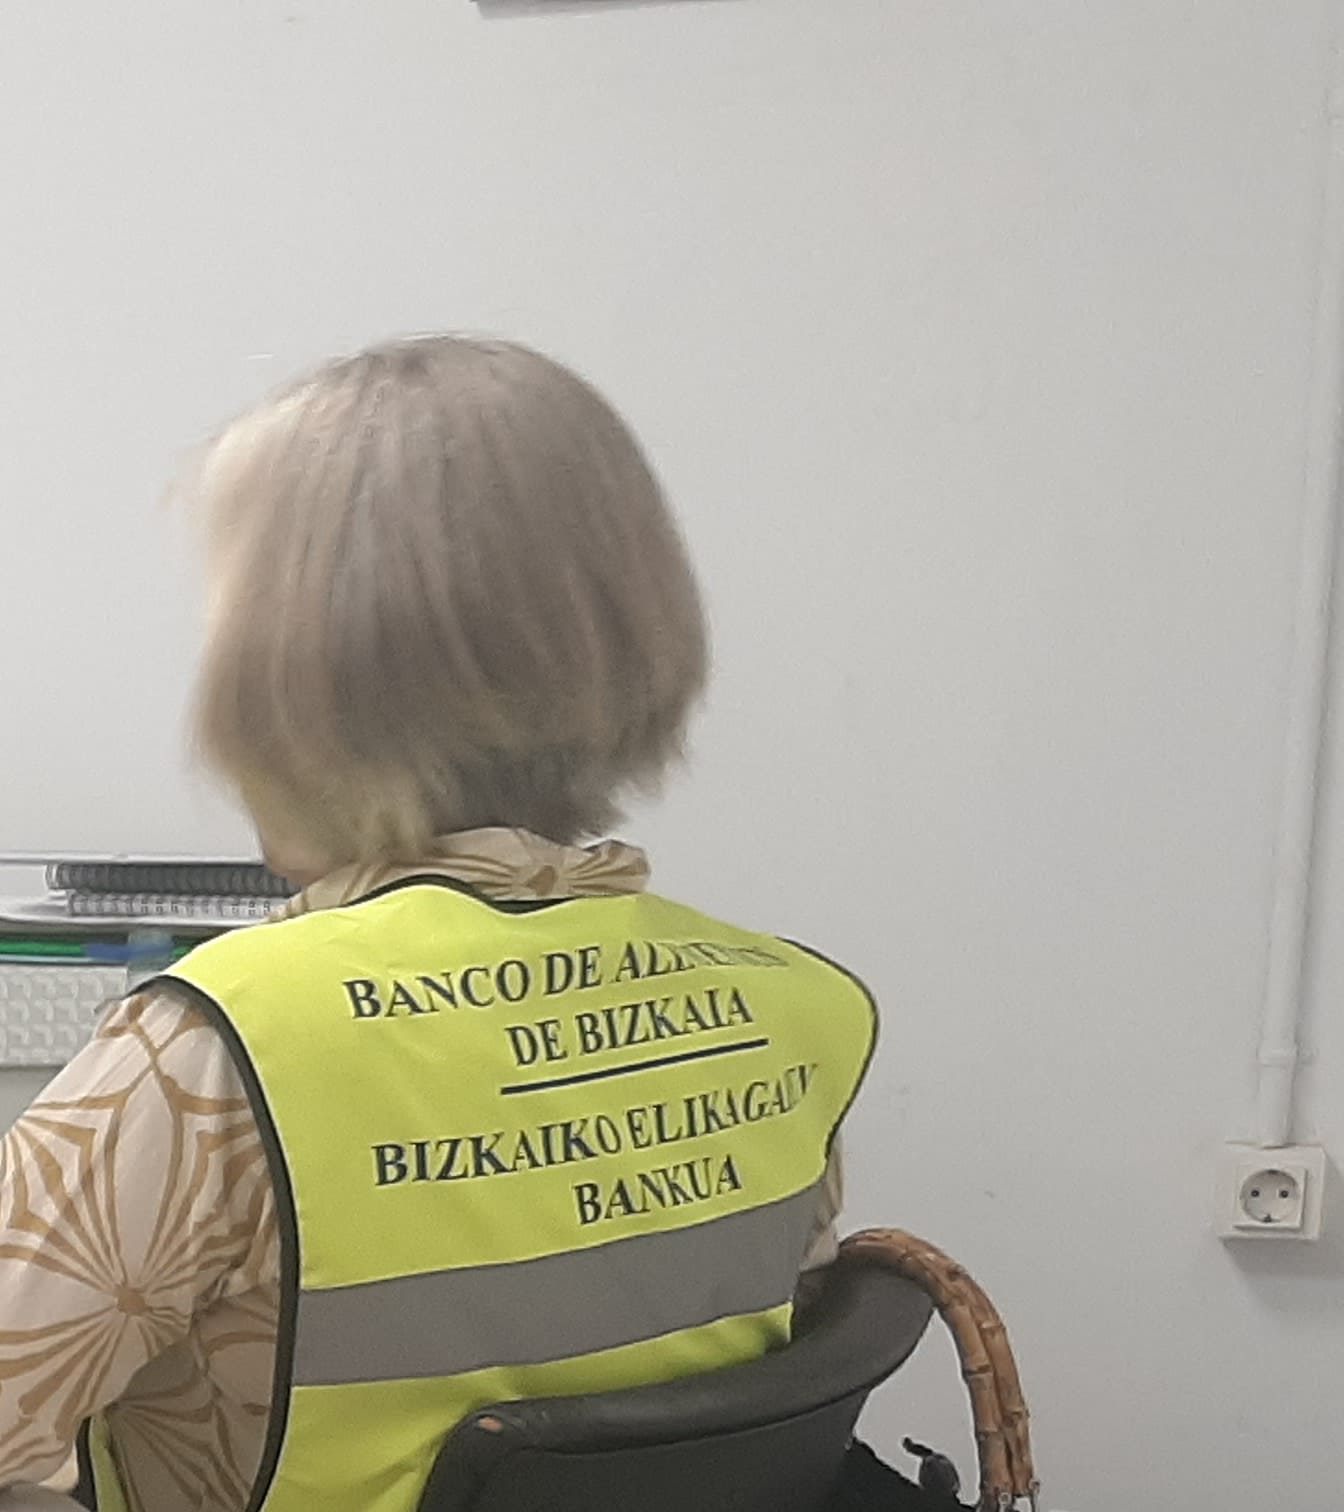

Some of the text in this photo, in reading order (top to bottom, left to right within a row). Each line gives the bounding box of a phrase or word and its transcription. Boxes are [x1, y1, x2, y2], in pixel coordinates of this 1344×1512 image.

[343, 960, 530, 1020] BANCO
[544, 945, 602, 997] DE
[505, 986, 755, 1066] DE BIZKAIA
[371, 1117, 622, 1187] BIZKAIKO
[572, 1154, 743, 1226] BANKUA
